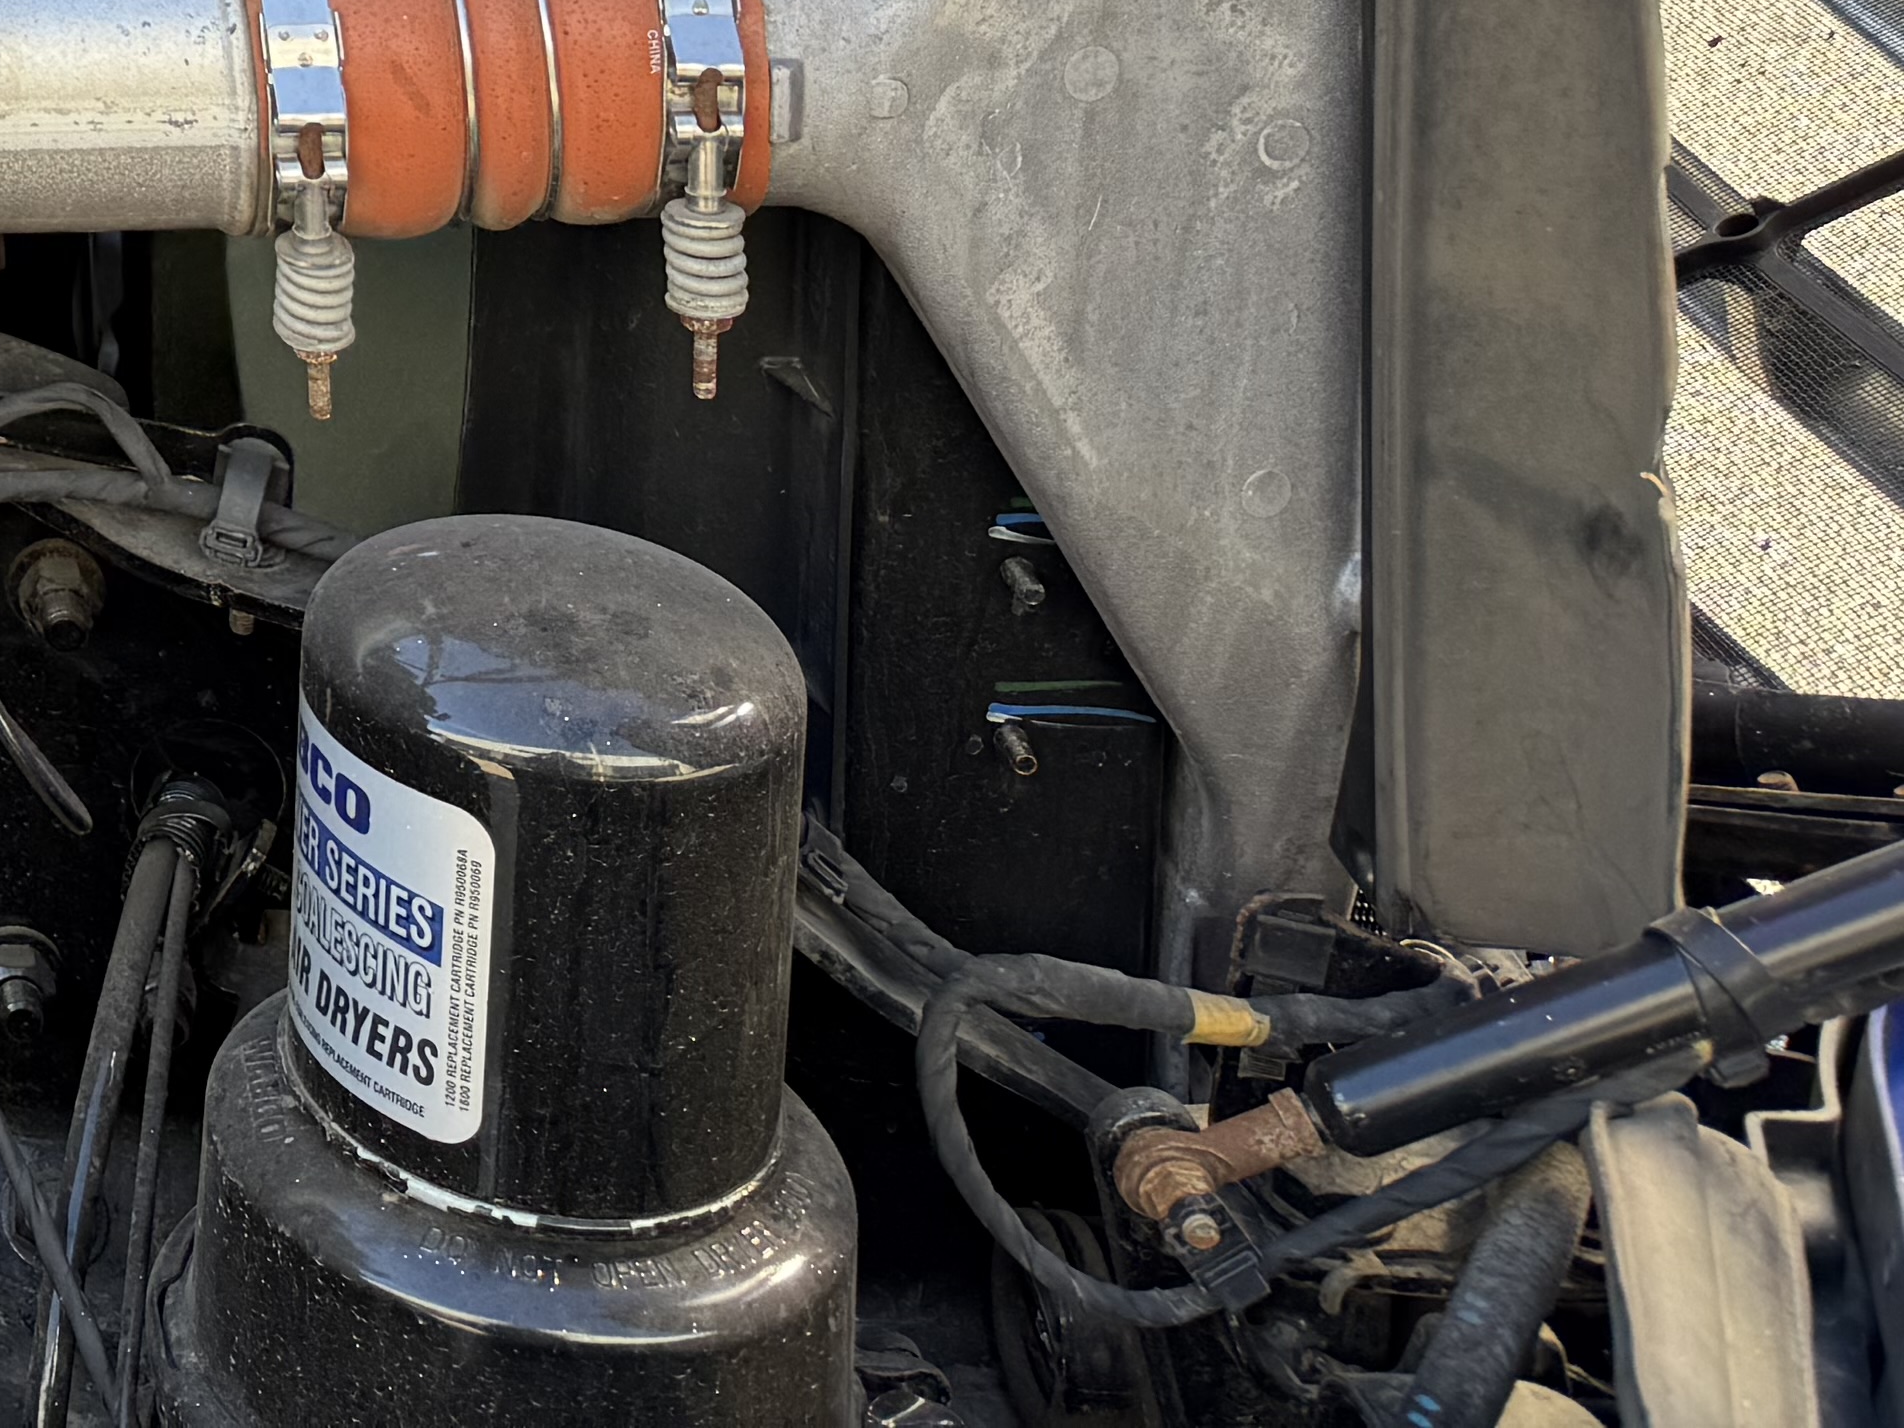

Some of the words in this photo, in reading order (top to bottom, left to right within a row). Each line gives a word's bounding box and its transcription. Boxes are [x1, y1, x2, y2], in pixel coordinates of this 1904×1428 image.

[647, 29, 661, 75] CHINA
[299, 715, 372, 835] BCO
[326, 844, 434, 948] SERIES
[453, 909, 464, 925] PN
[468, 913, 479, 929] PN
[451, 929, 464, 992] CARTRIDGE
[464, 934, 478, 997] CARTRIDGE
[315, 968, 440, 1087] DRYERS
[447, 995, 461, 1077] REPLACEMENT
[460, 1000, 475, 1082] REPLACEMENT
[373, 1081, 426, 1119] CARTRIDGE
[445, 1081, 456, 1107] 1200
[494, 1251, 561, 1286] NOT
[592, 1257, 687, 1289] OPEN
